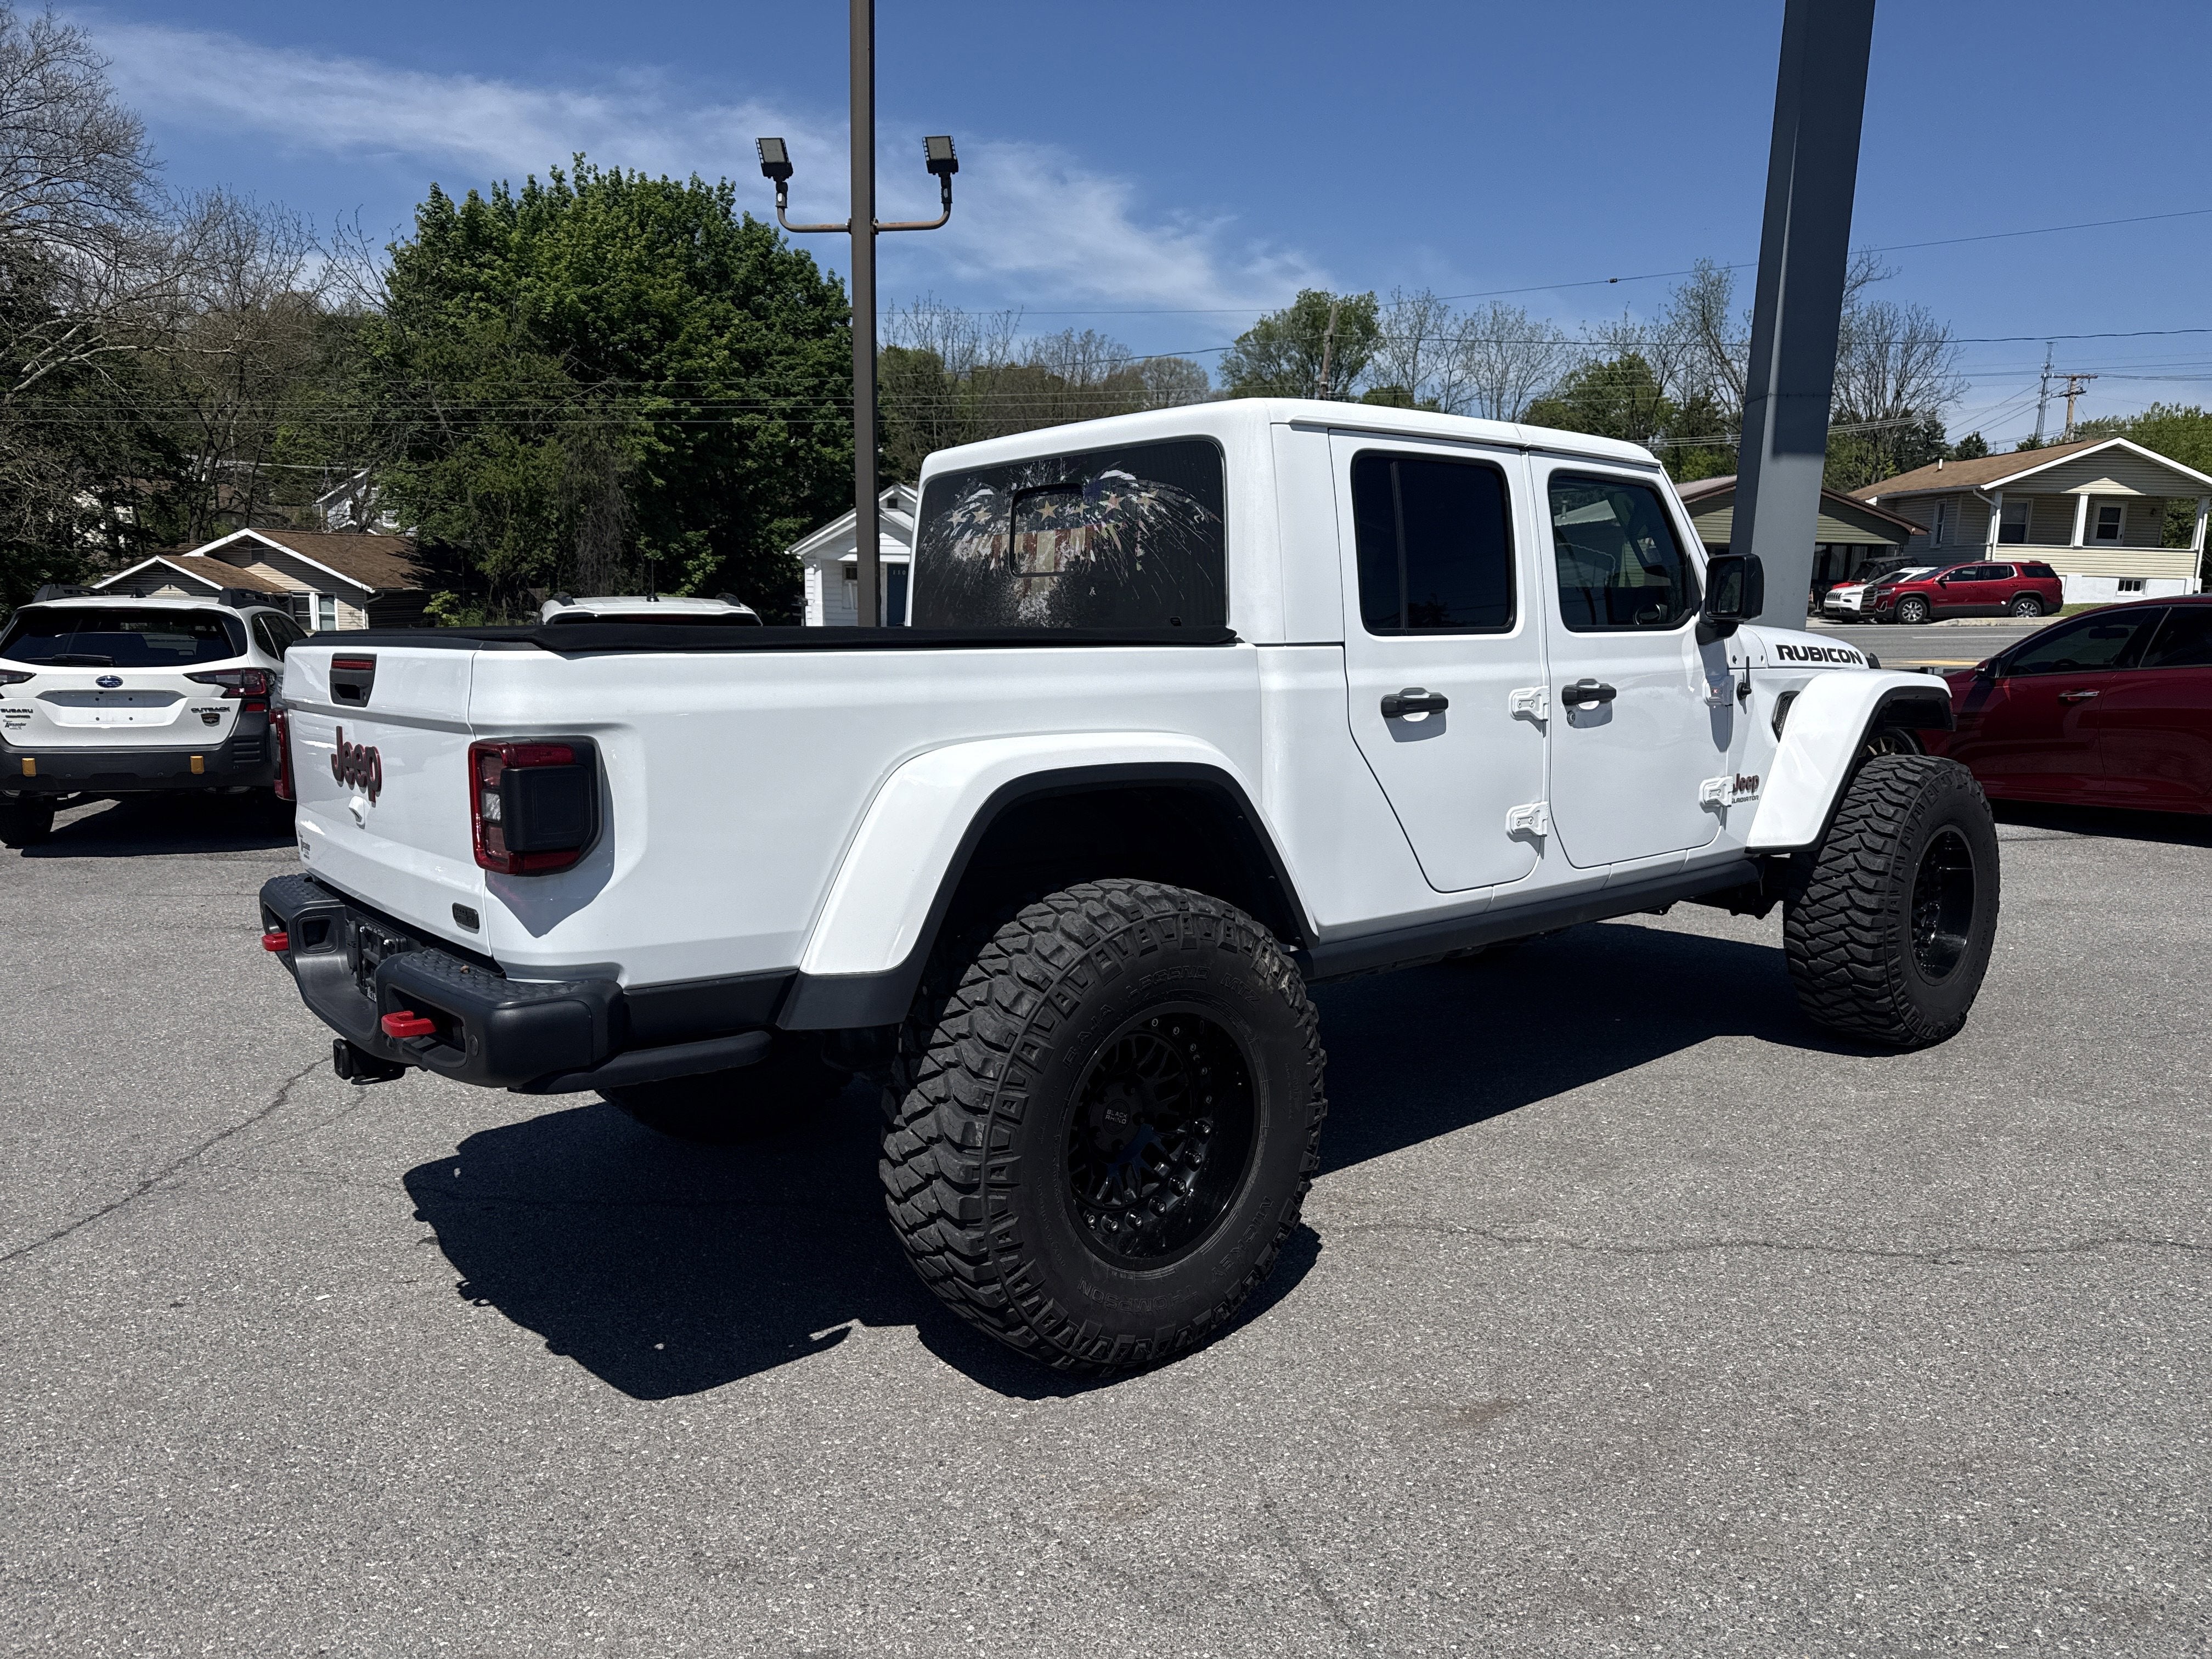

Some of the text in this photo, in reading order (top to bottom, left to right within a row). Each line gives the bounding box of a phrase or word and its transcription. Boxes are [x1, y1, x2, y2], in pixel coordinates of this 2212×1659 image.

[1775, 645, 1863, 664] RUBICON
[330, 725, 382, 803] Jeep
[1733, 773, 1760, 794] Jeep
[1219, 972, 1261, 1008] MTZ
[1105, 1115, 1126, 1124] RHINO
[1107, 1109, 1128, 1119] BLACK
[1076, 1276, 1198, 1313] THOMPSON
